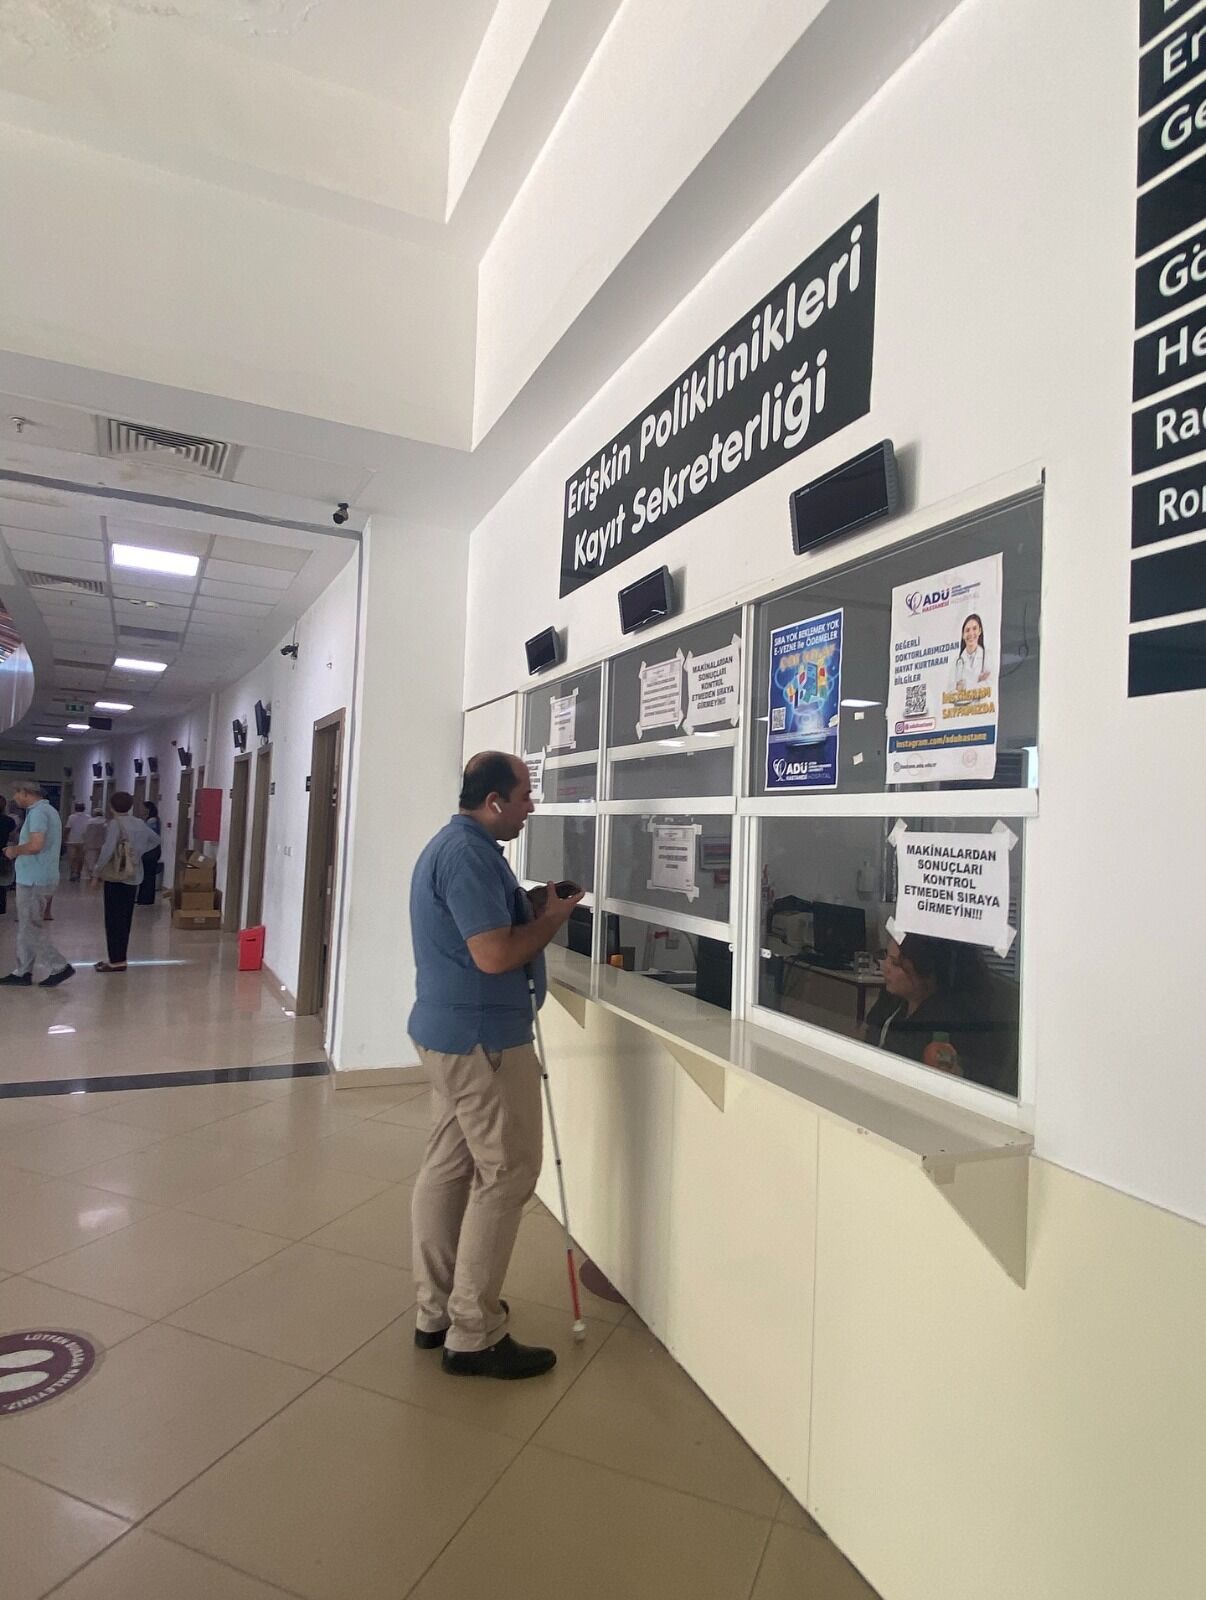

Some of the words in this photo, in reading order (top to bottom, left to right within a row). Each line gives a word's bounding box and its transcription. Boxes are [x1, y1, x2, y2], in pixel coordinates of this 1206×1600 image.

[1159, 243, 1206, 297] Gö
[1158, 325, 1206, 376] He
[567, 441, 631, 519] Erişkin
[639, 224, 863, 463] Poliklinikleri
[574, 510, 626, 571] Kayıt
[631, 348, 828, 535] Sekreterliği
[923, 588, 950, 607] ADÜ
[786, 632, 798, 643] YOK
[827, 619, 840, 631] YOK
[895, 636, 920, 651] DEĞERLİ
[895, 641, 960, 663] DOKTORLARIMIZDAN
[895, 663, 913, 674] HAYAT
[914, 656, 949, 670] KURTARAN
[894, 674, 922, 686] BİLGİLER
[786, 762, 808, 775] ADÜ
[906, 844, 996, 862] MAKİNALARDAN
[917, 859, 983, 876] SONUÇLARI
[923, 873, 977, 890] KONTROL
[904, 885, 954, 901] ETMEDEN
[957, 891, 1001, 908] SIRAYA
[917, 898, 983, 920] GİRMEYİN!!!
